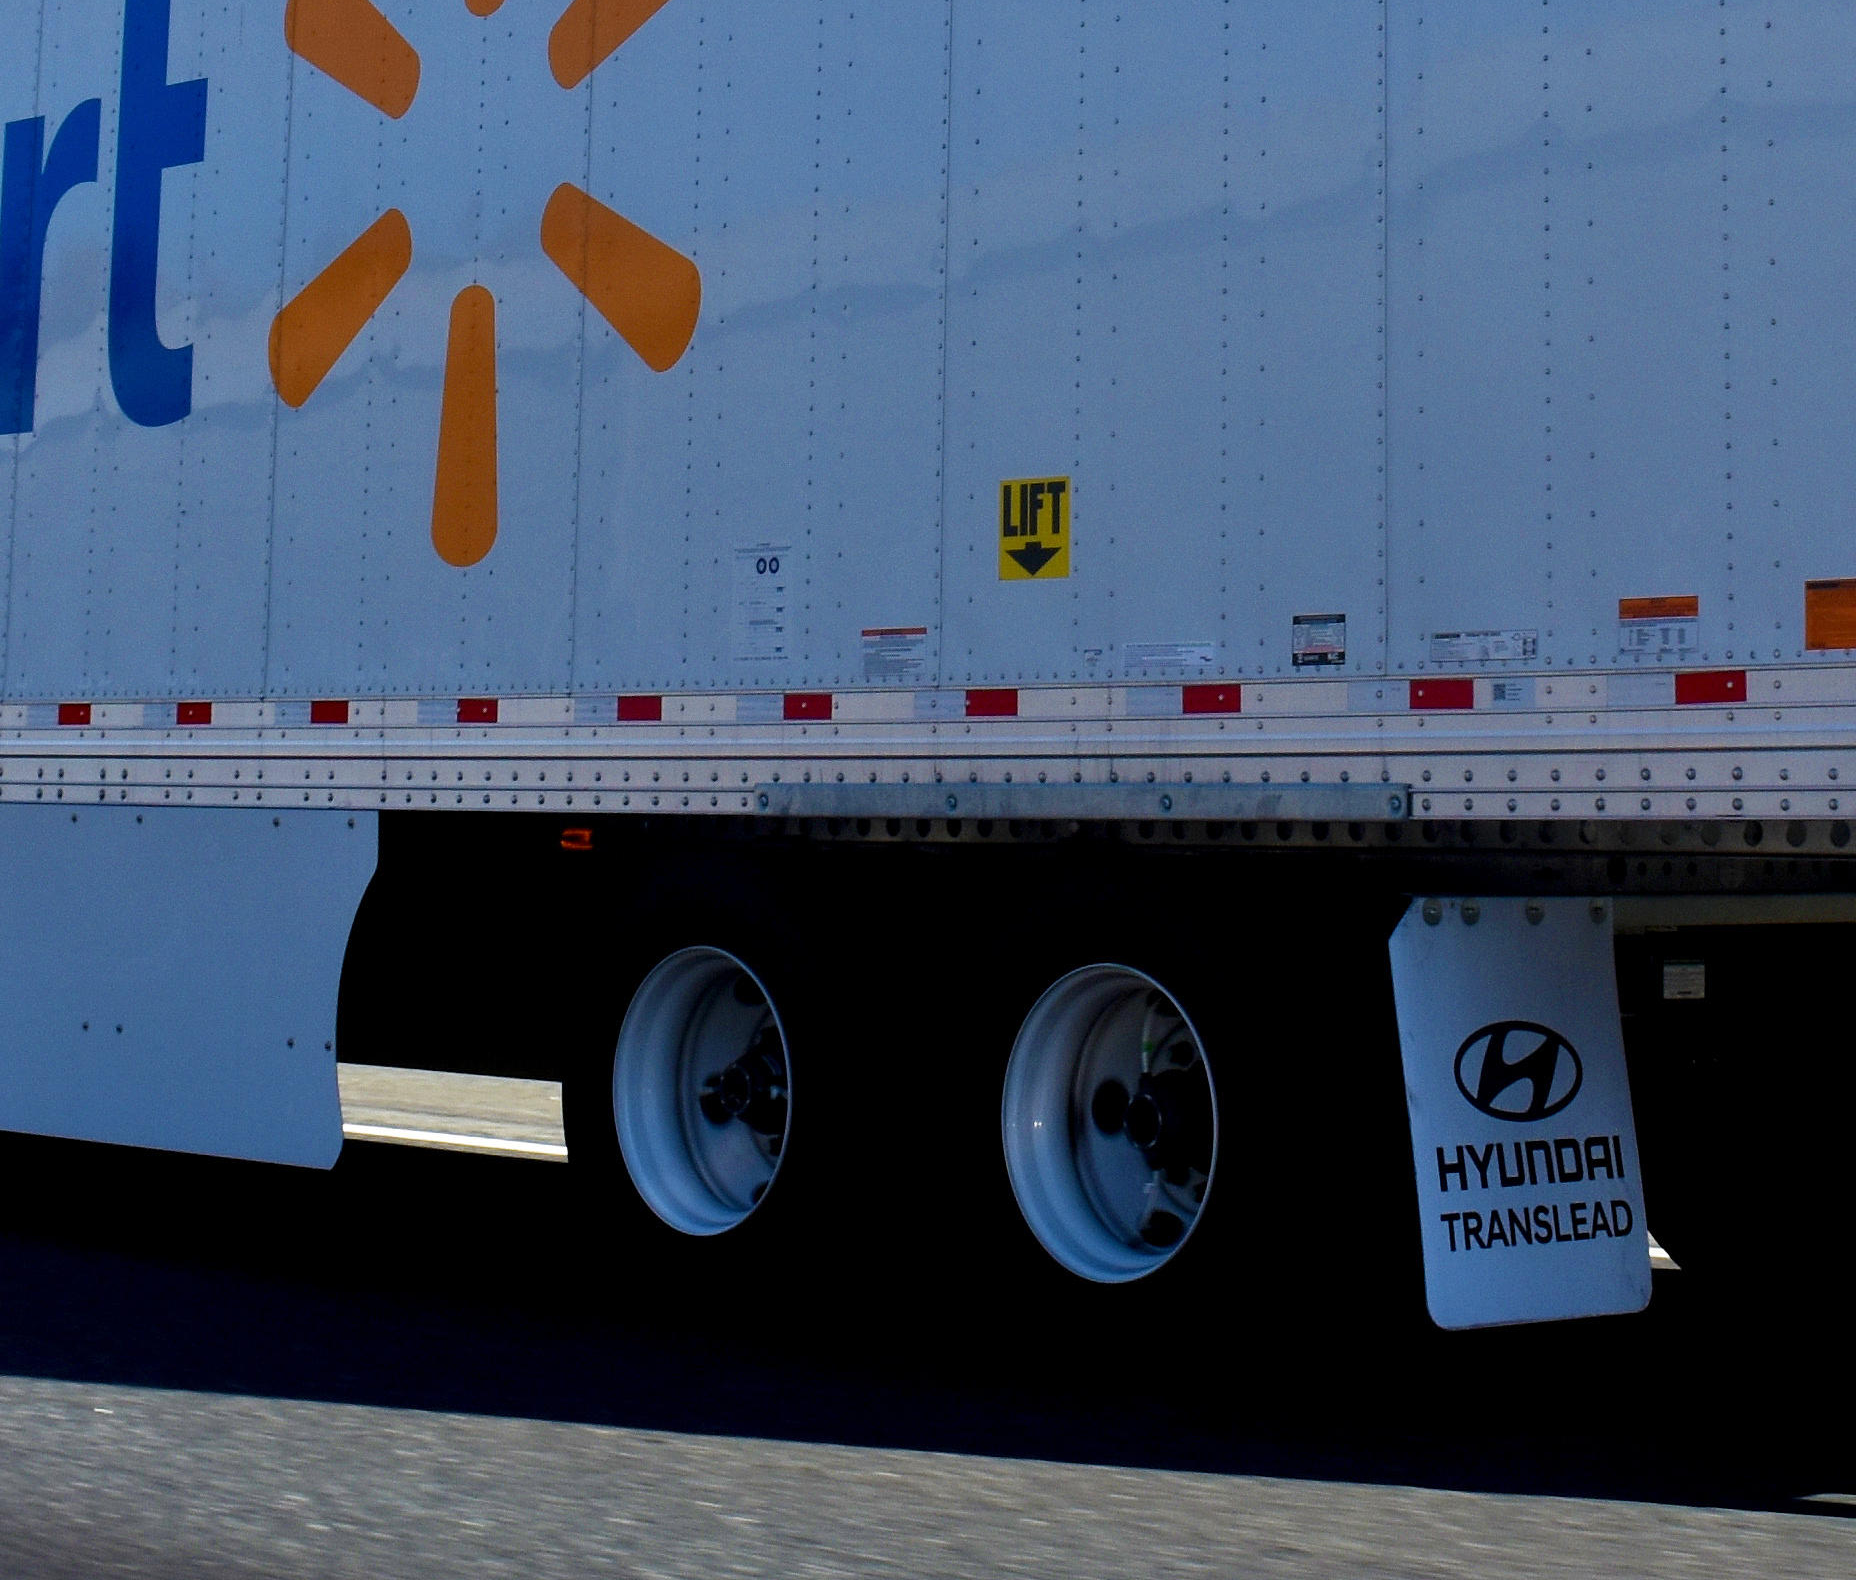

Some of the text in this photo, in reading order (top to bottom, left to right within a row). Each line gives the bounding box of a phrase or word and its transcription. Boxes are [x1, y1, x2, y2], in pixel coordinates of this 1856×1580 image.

[1003, 481, 1066, 537] LIFT
[1436, 1134, 1625, 1192] HYUNDAI
[1440, 1199, 1634, 1252] TRANSLEAD
